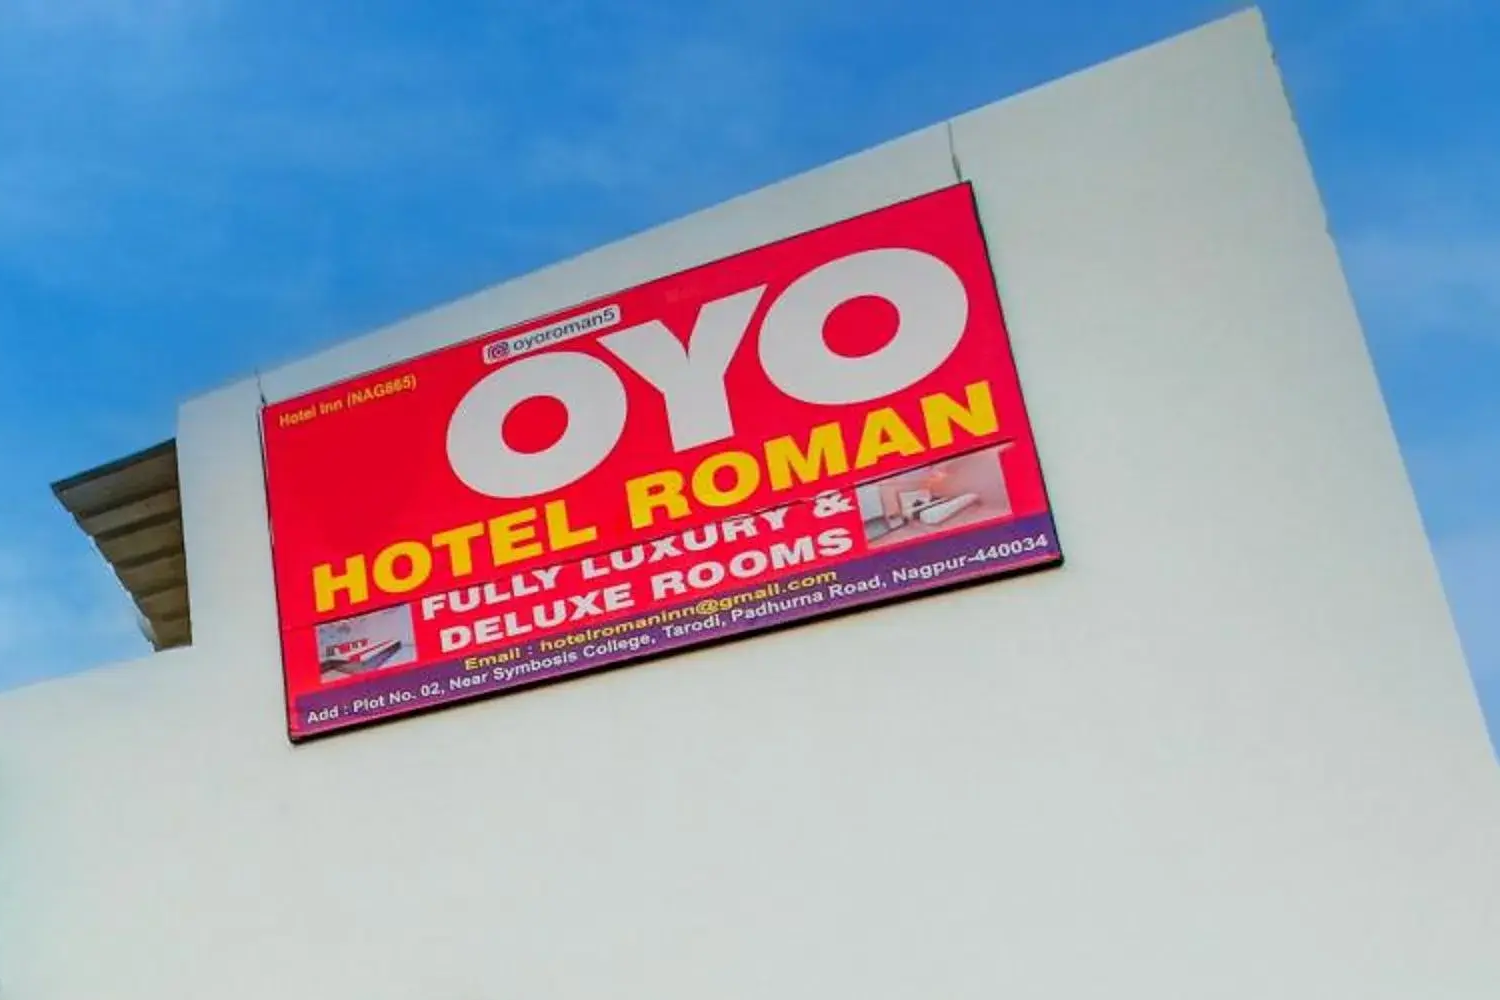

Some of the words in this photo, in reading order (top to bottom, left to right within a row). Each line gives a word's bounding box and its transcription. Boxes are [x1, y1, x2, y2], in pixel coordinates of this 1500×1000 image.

[279, 406, 317, 428] Hotel
[320, 399, 343, 415] Inn
[446, 246, 969, 499] OYO
[311, 499, 598, 614] HOTEL
[625, 381, 1000, 530] ROMAN
[421, 564, 565, 621] FULLY
[581, 507, 790, 580] LUXURY
[812, 490, 855, 519] &
[307, 704, 340, 725] Add
[353, 696, 385, 714] Plot
[389, 690, 417, 706] No.
[421, 681, 446, 698] 02,
[450, 673, 488, 694] Near
[493, 651, 579, 684] Symbosis
[583, 633, 657, 658] College,
[662, 615, 727, 640] Tarodi,
[731, 589, 823, 623] Padhurna
[829, 574, 888, 598] Road,
[892, 533, 1049, 584] Nagpur-440034
[440, 581, 633, 654] DELUXE
[651, 526, 854, 600] ROOMS
[464, 647, 522, 671] Email
[540, 570, 838, 653] hotelromaninn@gmail.com
